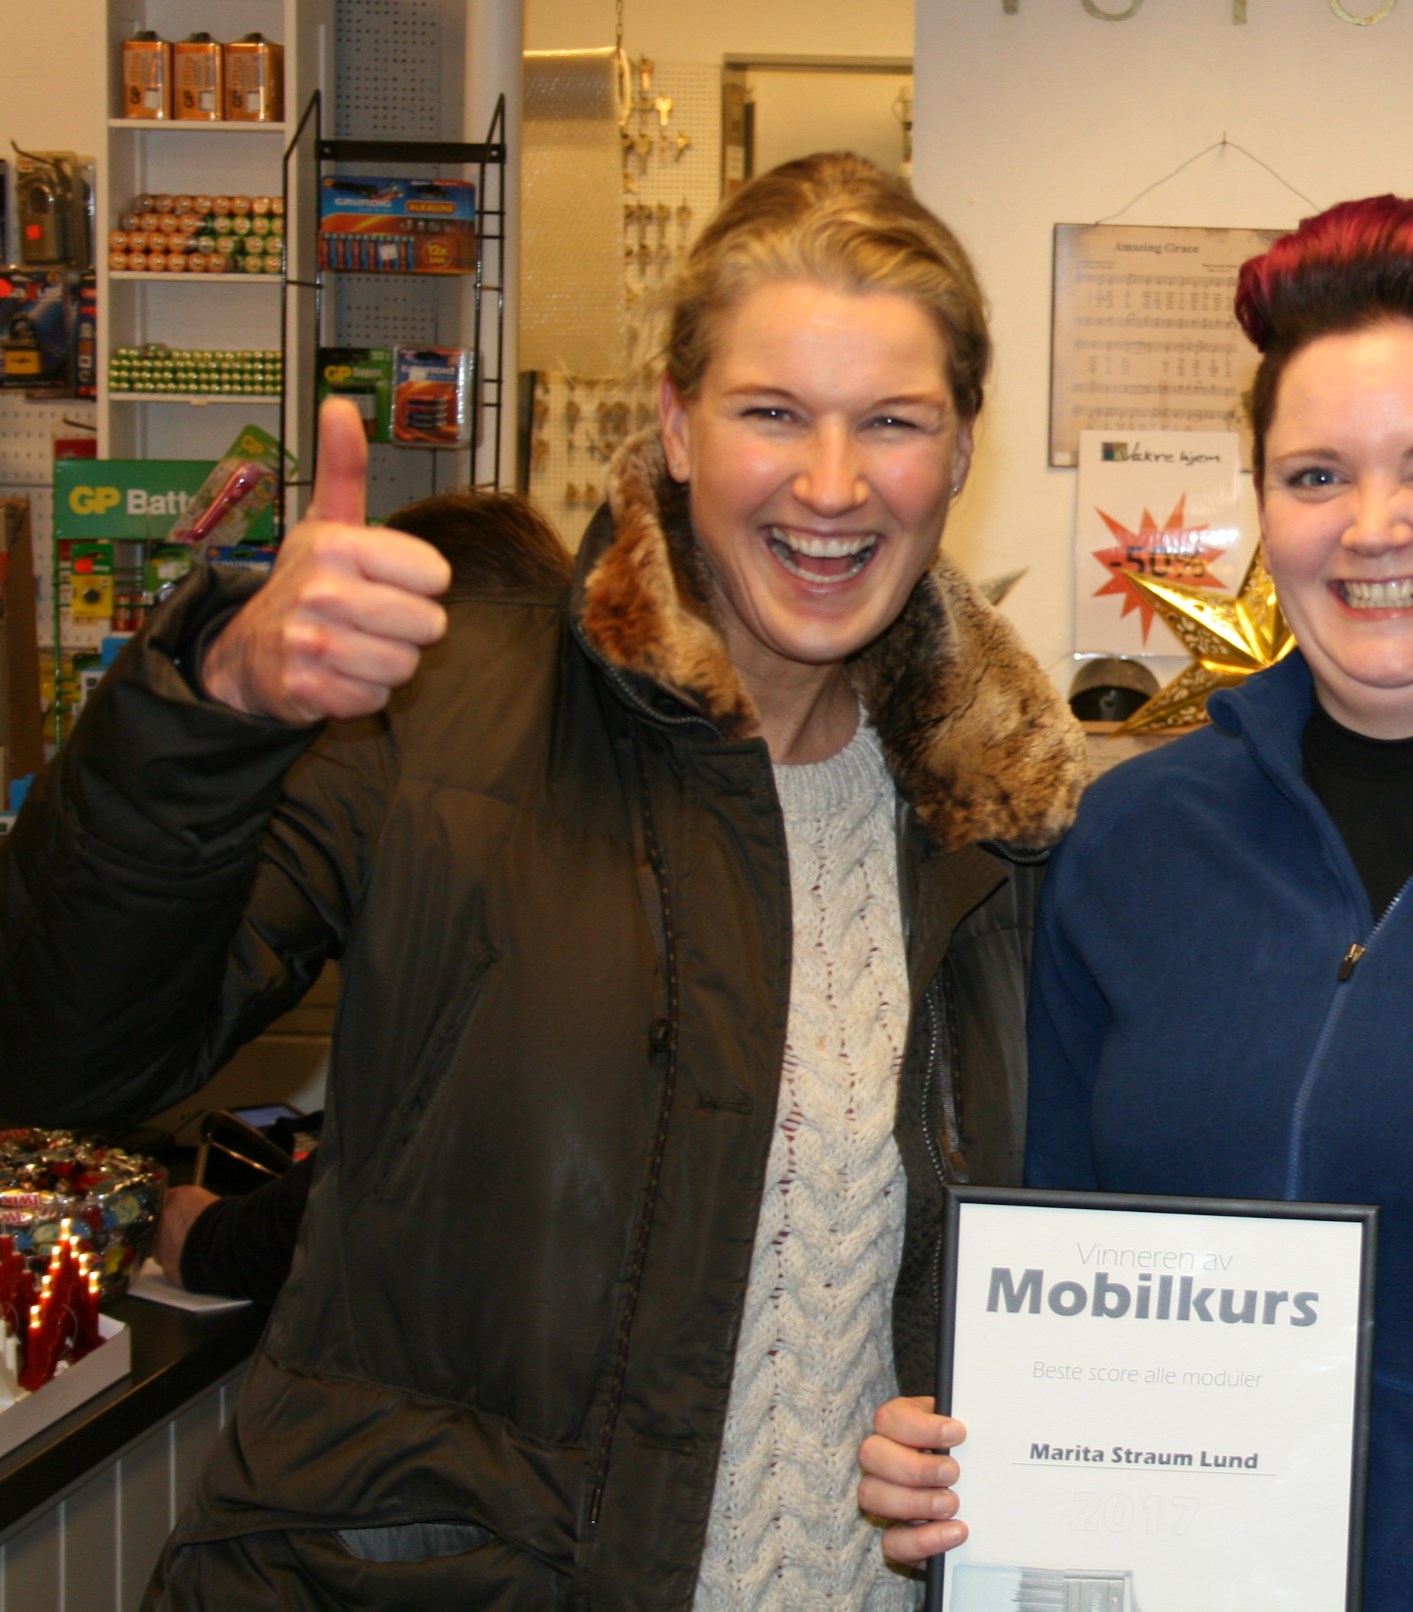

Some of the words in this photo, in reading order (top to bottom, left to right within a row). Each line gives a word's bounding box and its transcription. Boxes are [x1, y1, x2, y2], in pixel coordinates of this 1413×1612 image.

[1113, 242, 1162, 255] Amazing
[1165, 243, 1200, 254] Grace
[323, 365, 352, 382] GP
[68, 485, 122, 516] GP
[126, 489, 196, 516] Batt
[1076, 1242, 1195, 1269] Vinneren
[1202, 1250, 1233, 1271] av
[986, 1266, 1320, 1328] Mobilkurs
[1032, 1361, 1084, 1381] Beste
[1088, 1365, 1139, 1383] score
[1144, 1367, 1177, 1385] alle
[1182, 1370, 1264, 1388] moduler
[1029, 1443, 1105, 1463] Marita
[1111, 1446, 1194, 1467] Straum
[1199, 1450, 1259, 1469] Lund
[1069, 1491, 1200, 1536] 2017
